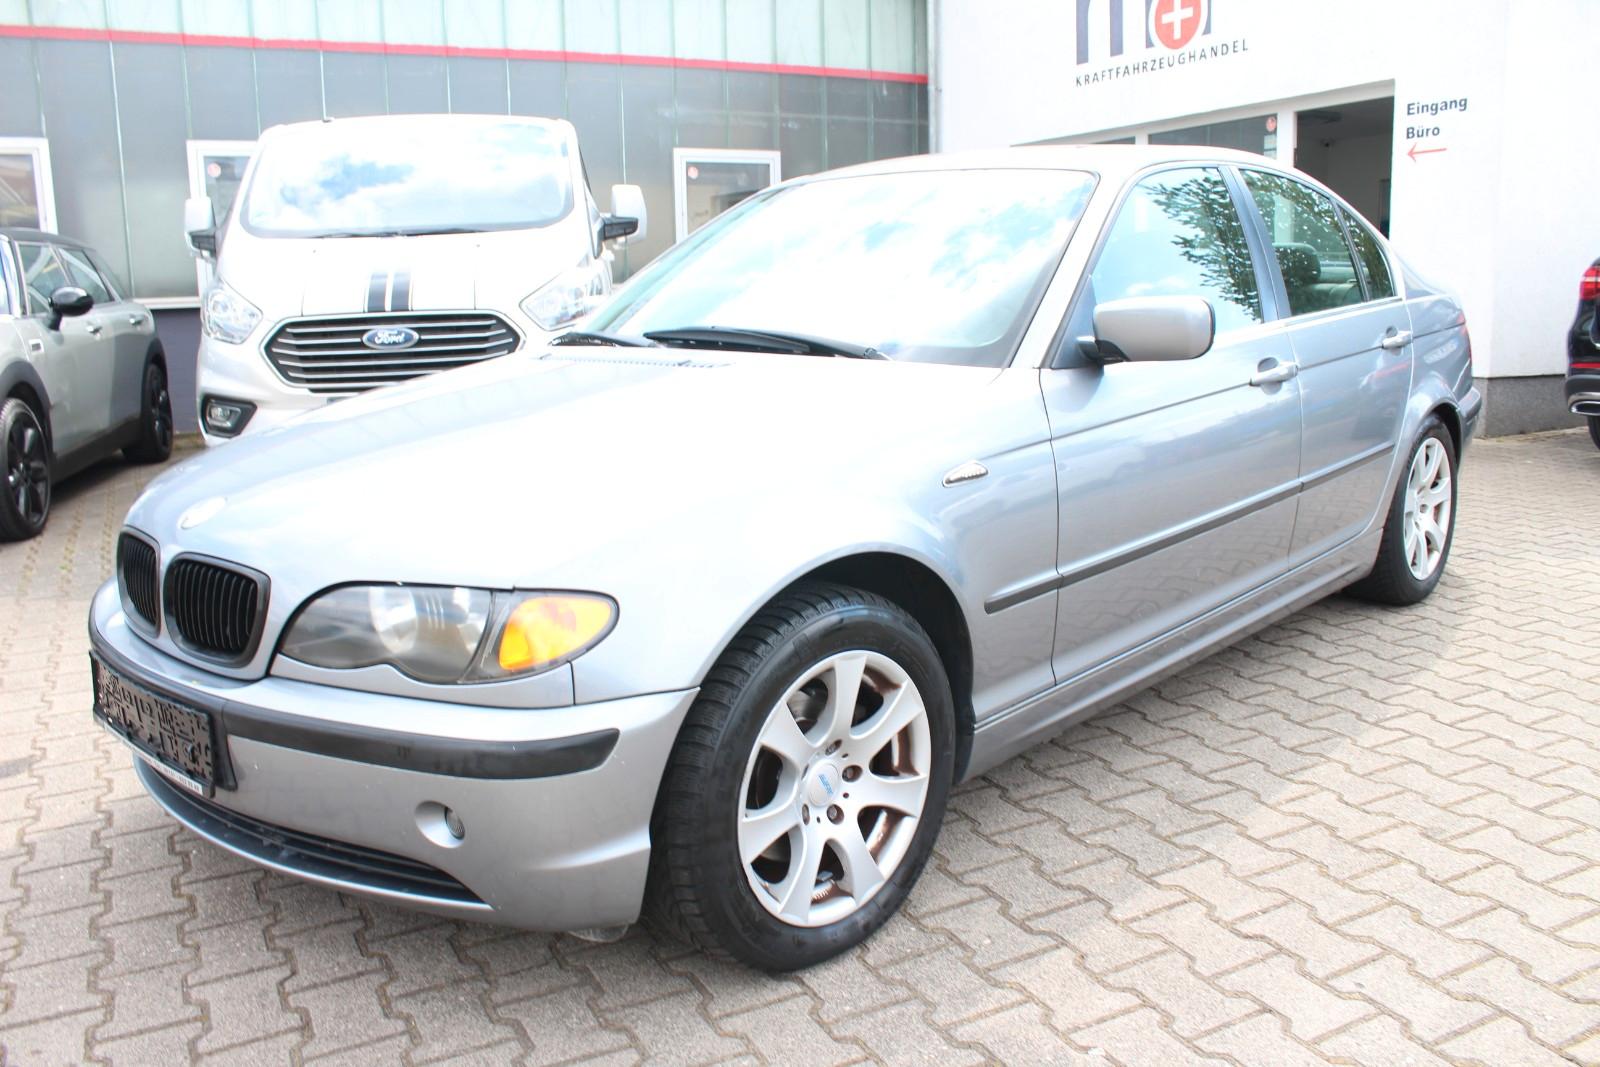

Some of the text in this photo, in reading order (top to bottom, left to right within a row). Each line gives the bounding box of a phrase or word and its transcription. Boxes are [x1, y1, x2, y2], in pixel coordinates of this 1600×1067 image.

[1075, 38, 1248, 87] KRAFTFAHRZEUGHANDEL
[1407, 98, 1468, 116] Eingang
[1406, 125, 1440, 139] Büro
[374, 329, 406, 345] Ford
